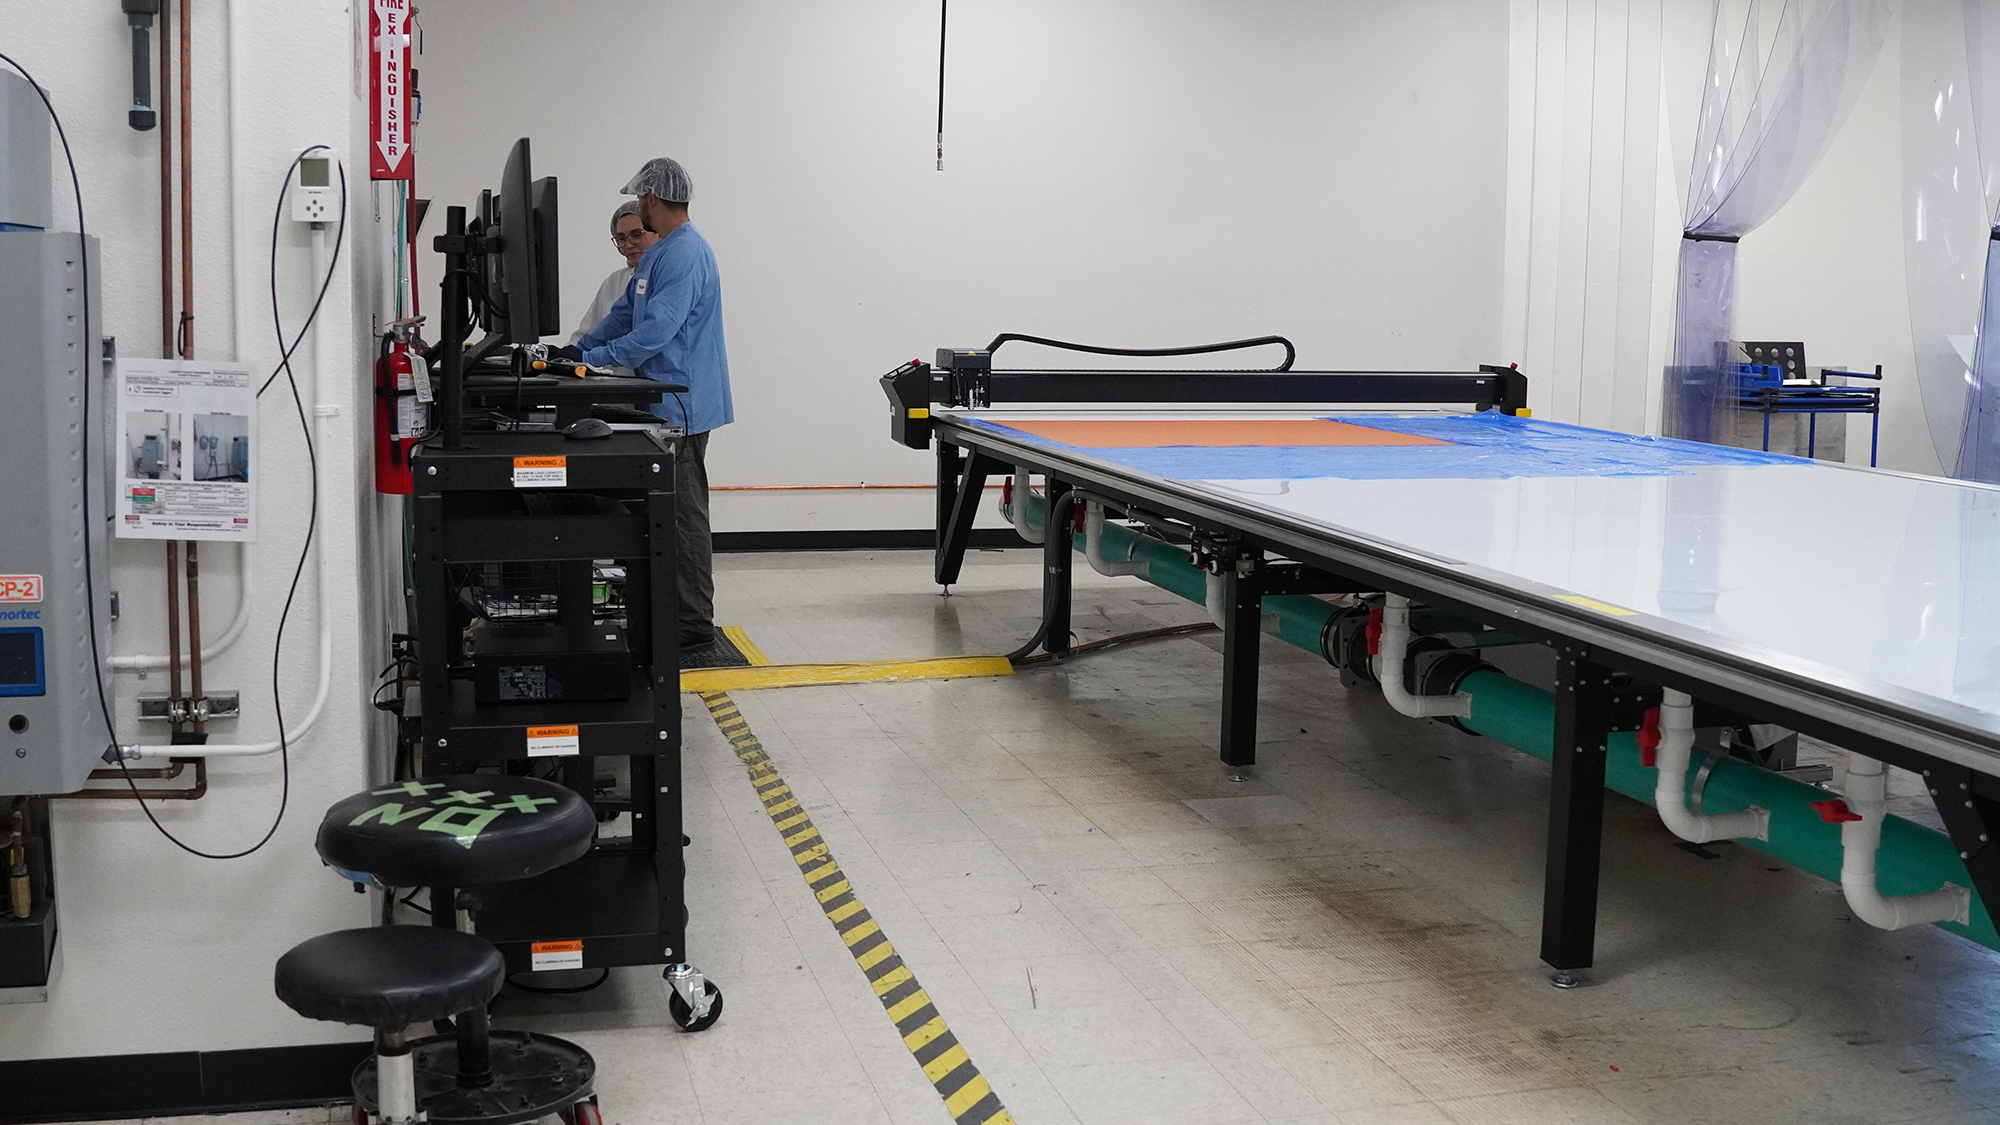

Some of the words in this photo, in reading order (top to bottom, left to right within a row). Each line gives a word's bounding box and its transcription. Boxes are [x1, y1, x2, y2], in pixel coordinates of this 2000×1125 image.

[0, 609, 41, 620] nortec
[537, 728, 570, 736] WARNING
[541, 943, 574, 951] WARNING
